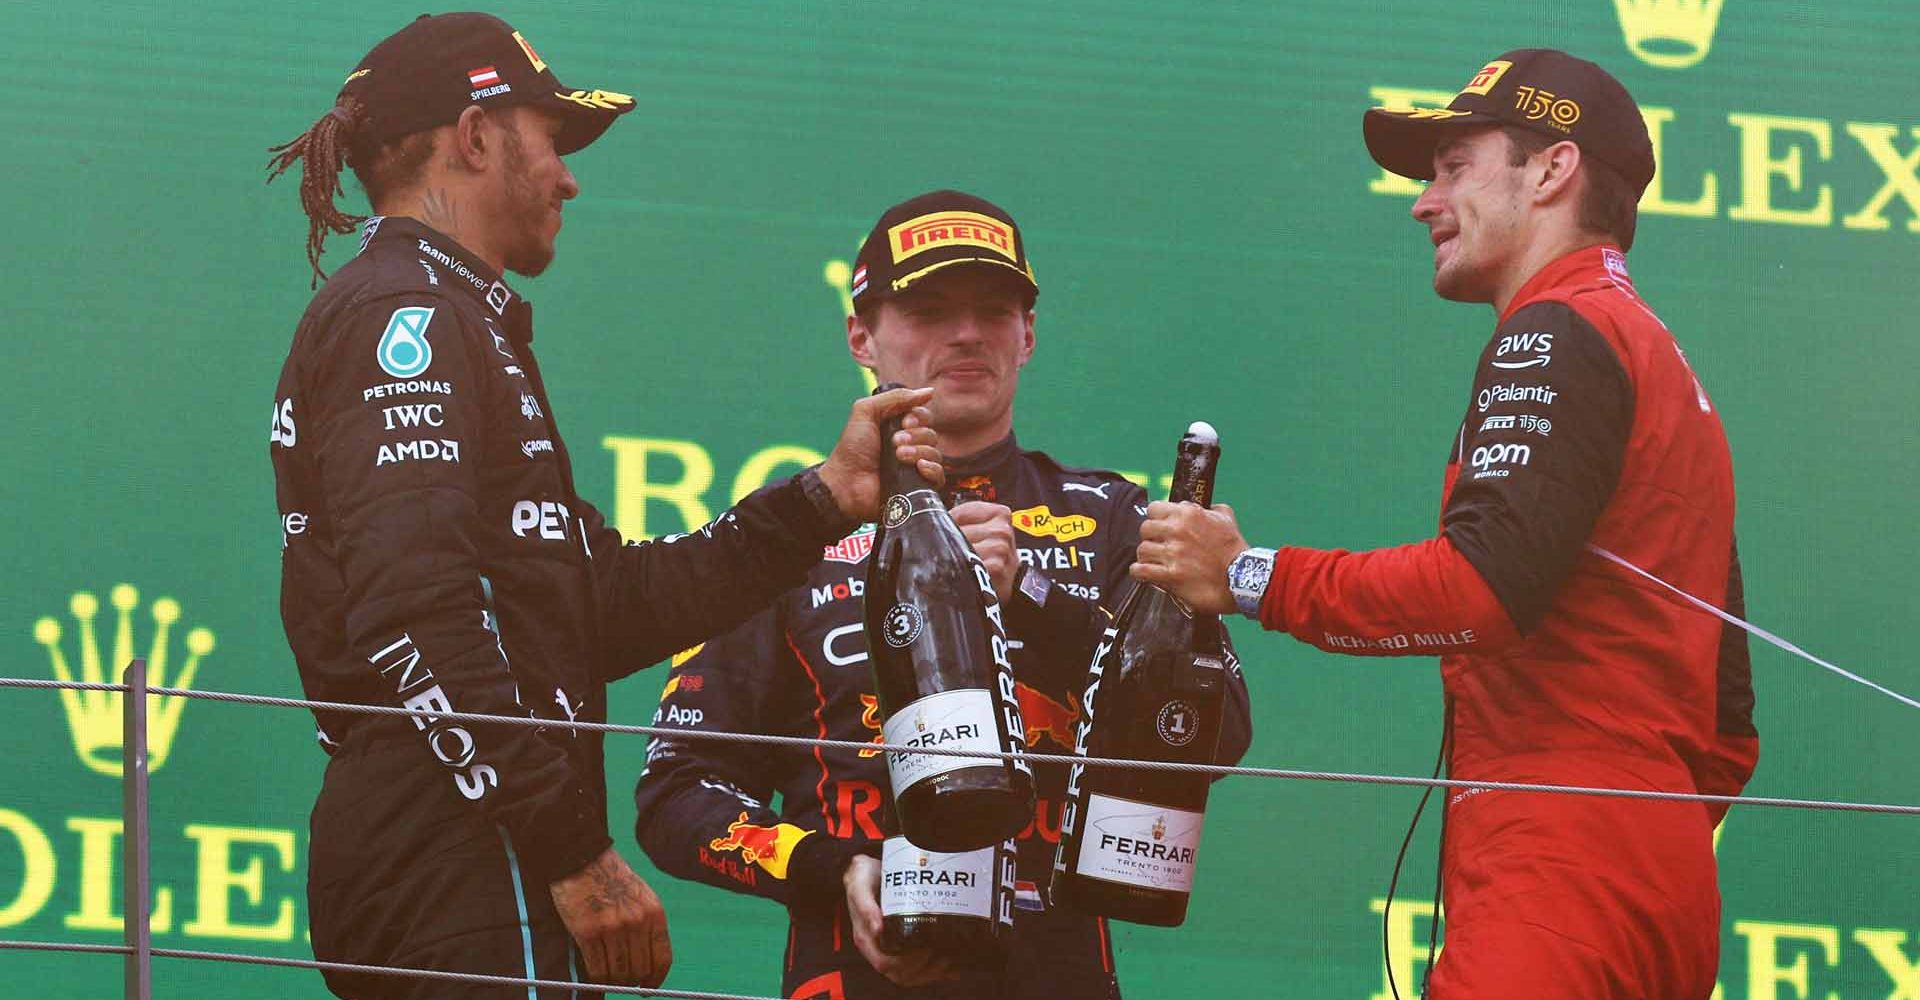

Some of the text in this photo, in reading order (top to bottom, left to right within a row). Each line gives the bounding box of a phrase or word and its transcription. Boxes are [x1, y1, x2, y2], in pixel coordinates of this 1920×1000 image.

[470, 83, 512, 101] SPIELBERG
[1516, 85, 1581, 126] 150
[899, 217, 1009, 253] PIRELLI
[418, 239, 489, 291] TeamViewer
[1496, 333, 1554, 357] aws
[363, 380, 452, 402] PETRONAS
[1490, 383, 1558, 406] Palantir
[382, 403, 444, 430] IWC
[376, 440, 441, 466] AMD
[1471, 443, 1531, 471] apm
[1474, 470, 1509, 479] MONACO
[893, 614, 911, 636] 3
[1324, 629, 1478, 651] RICHARD MILLE
[367, 632, 498, 800] INEOS
[666, 704, 704, 726] App
[1170, 713, 1185, 734] 1
[1054, 627, 1118, 874] FERRARI
[1100, 834, 1195, 864] FERRARI
[1117, 858, 1160, 872] TRENTO
[884, 869, 977, 889] FERRARI
[933, 889, 959, 899] 1902
